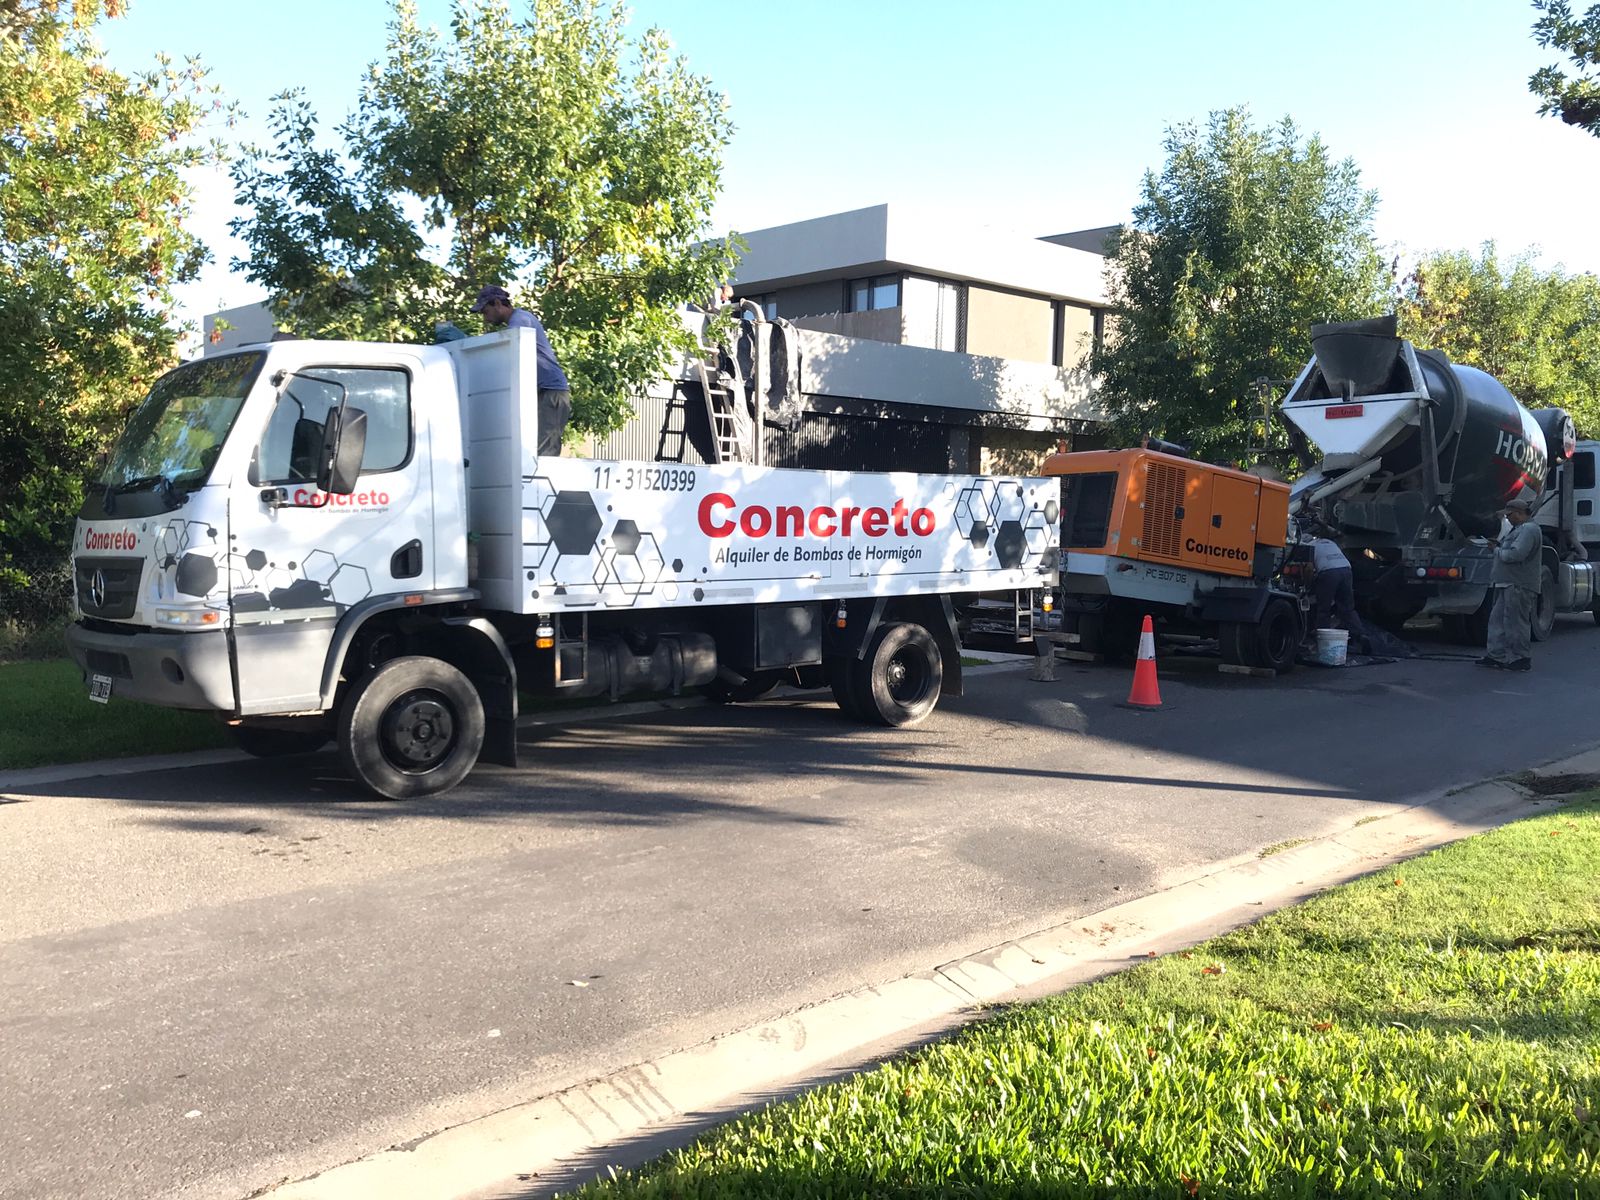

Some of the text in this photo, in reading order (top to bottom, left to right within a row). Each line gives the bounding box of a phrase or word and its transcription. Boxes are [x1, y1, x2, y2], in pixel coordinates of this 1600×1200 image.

[294, 488, 390, 507] Concreto
[697, 492, 936, 538] Concreto
[86, 527, 137, 550] Concreto
[1185, 538, 1249, 561] Concreto
[715, 545, 922, 567] Alquiler de Bombas de Hormigón
[1145, 568, 1157, 579] PC
